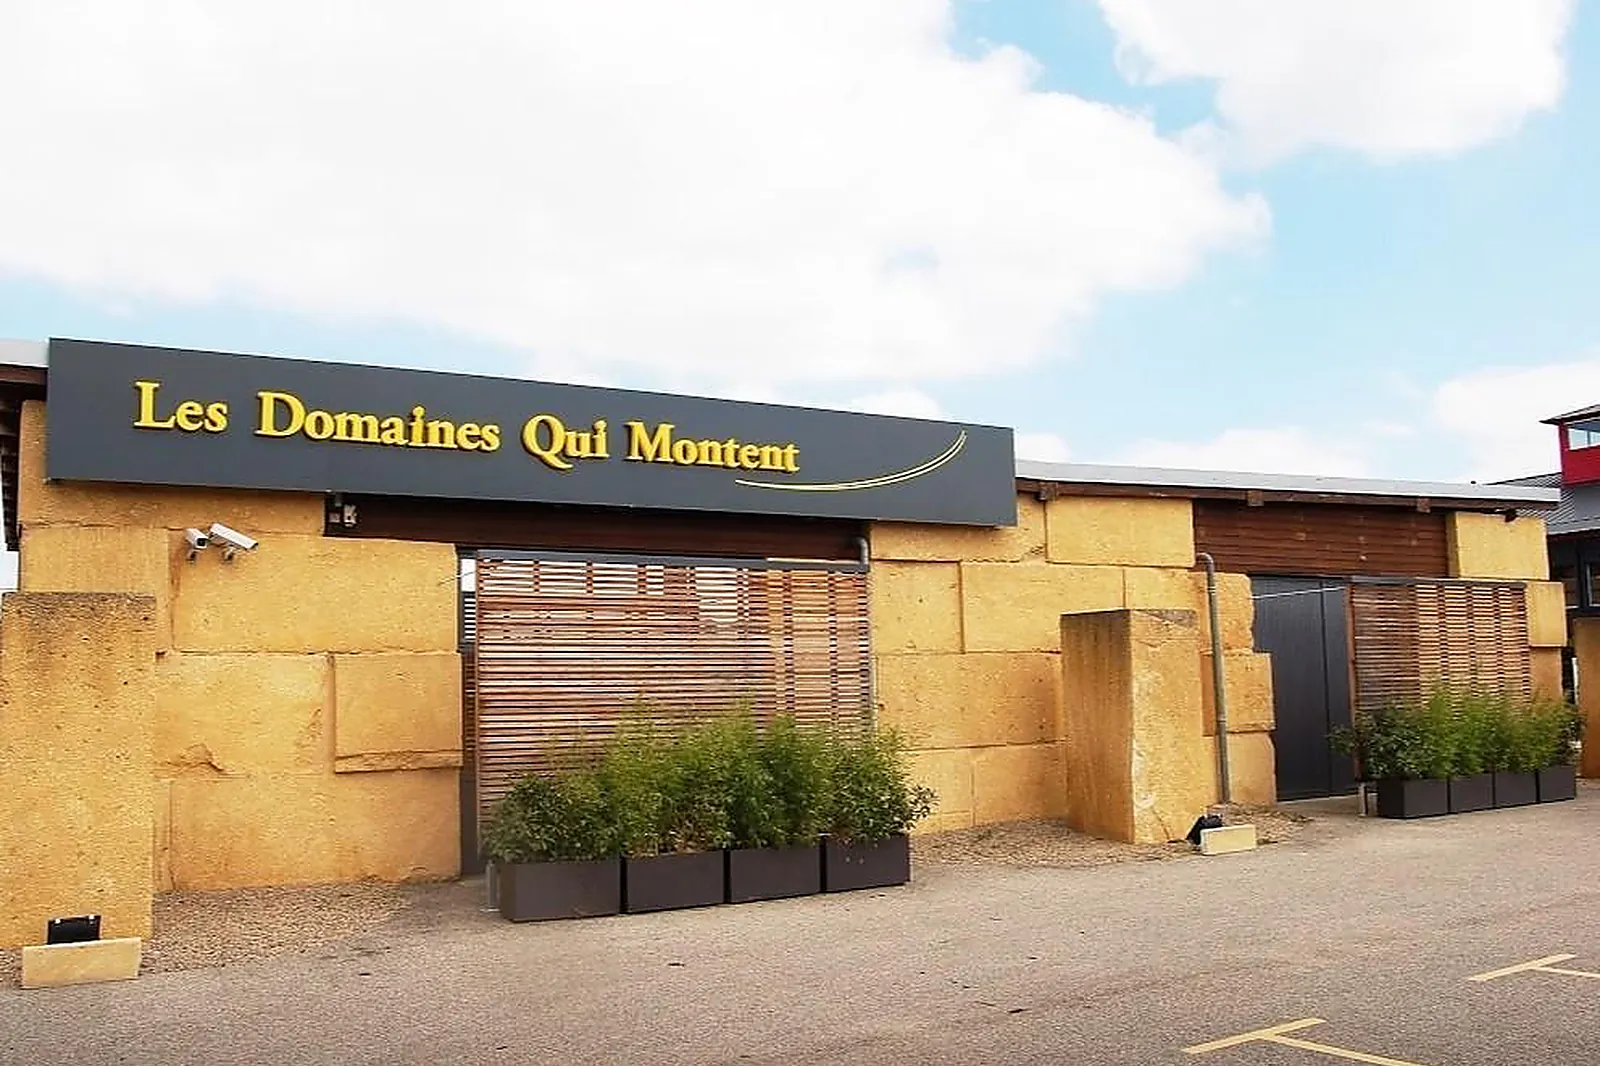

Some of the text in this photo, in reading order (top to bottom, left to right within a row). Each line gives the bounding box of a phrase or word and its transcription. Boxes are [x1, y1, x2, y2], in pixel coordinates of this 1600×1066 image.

[133, 381, 800, 473] Les Domaines Qui Montent
